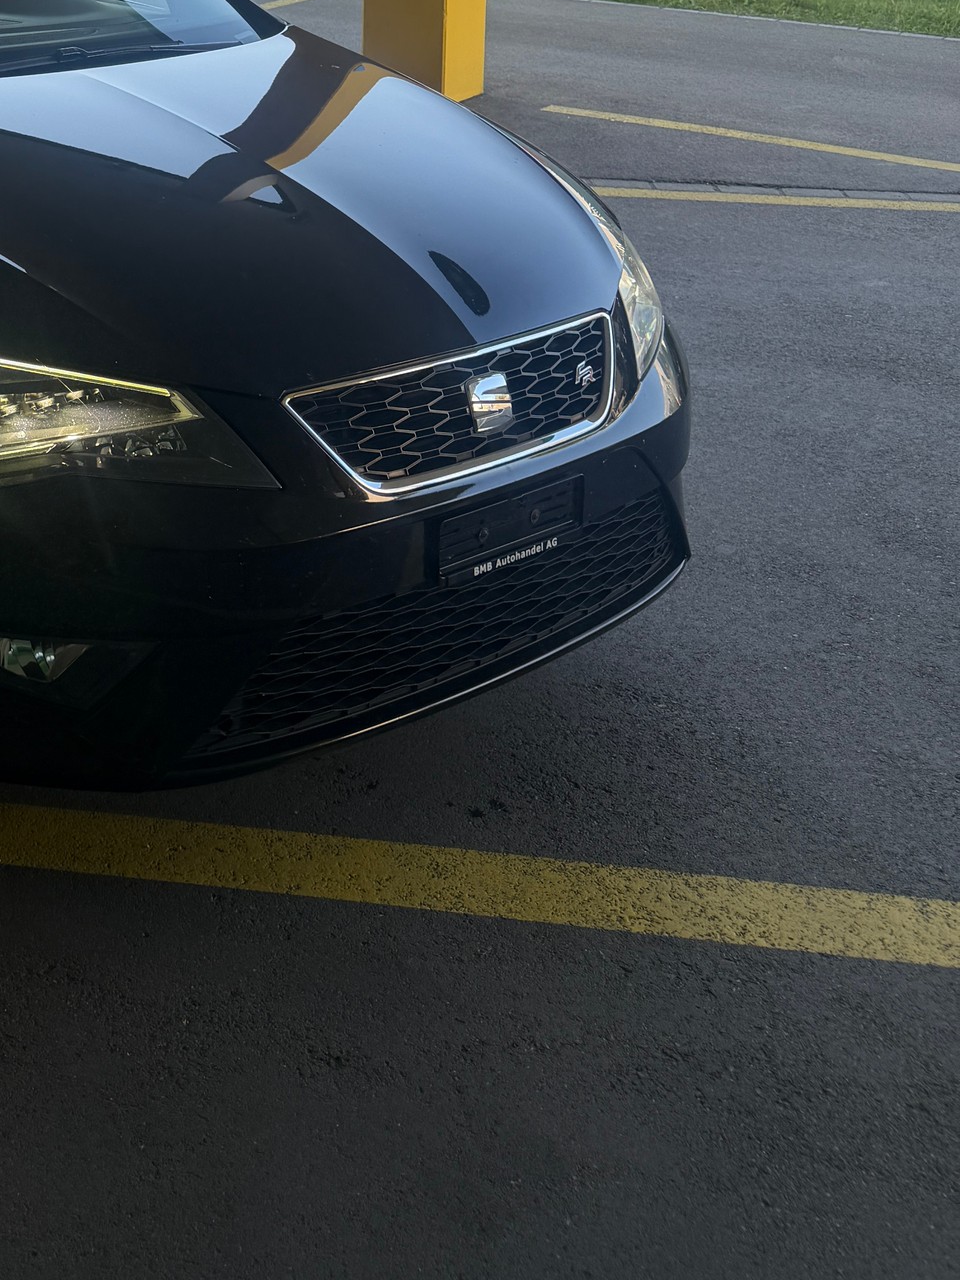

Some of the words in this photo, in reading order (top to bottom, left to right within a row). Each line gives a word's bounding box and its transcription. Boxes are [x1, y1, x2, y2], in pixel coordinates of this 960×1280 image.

[473, 562, 493, 577] BMB
[495, 542, 544, 568] Autohandel
[546, 537, 558, 550] AG
